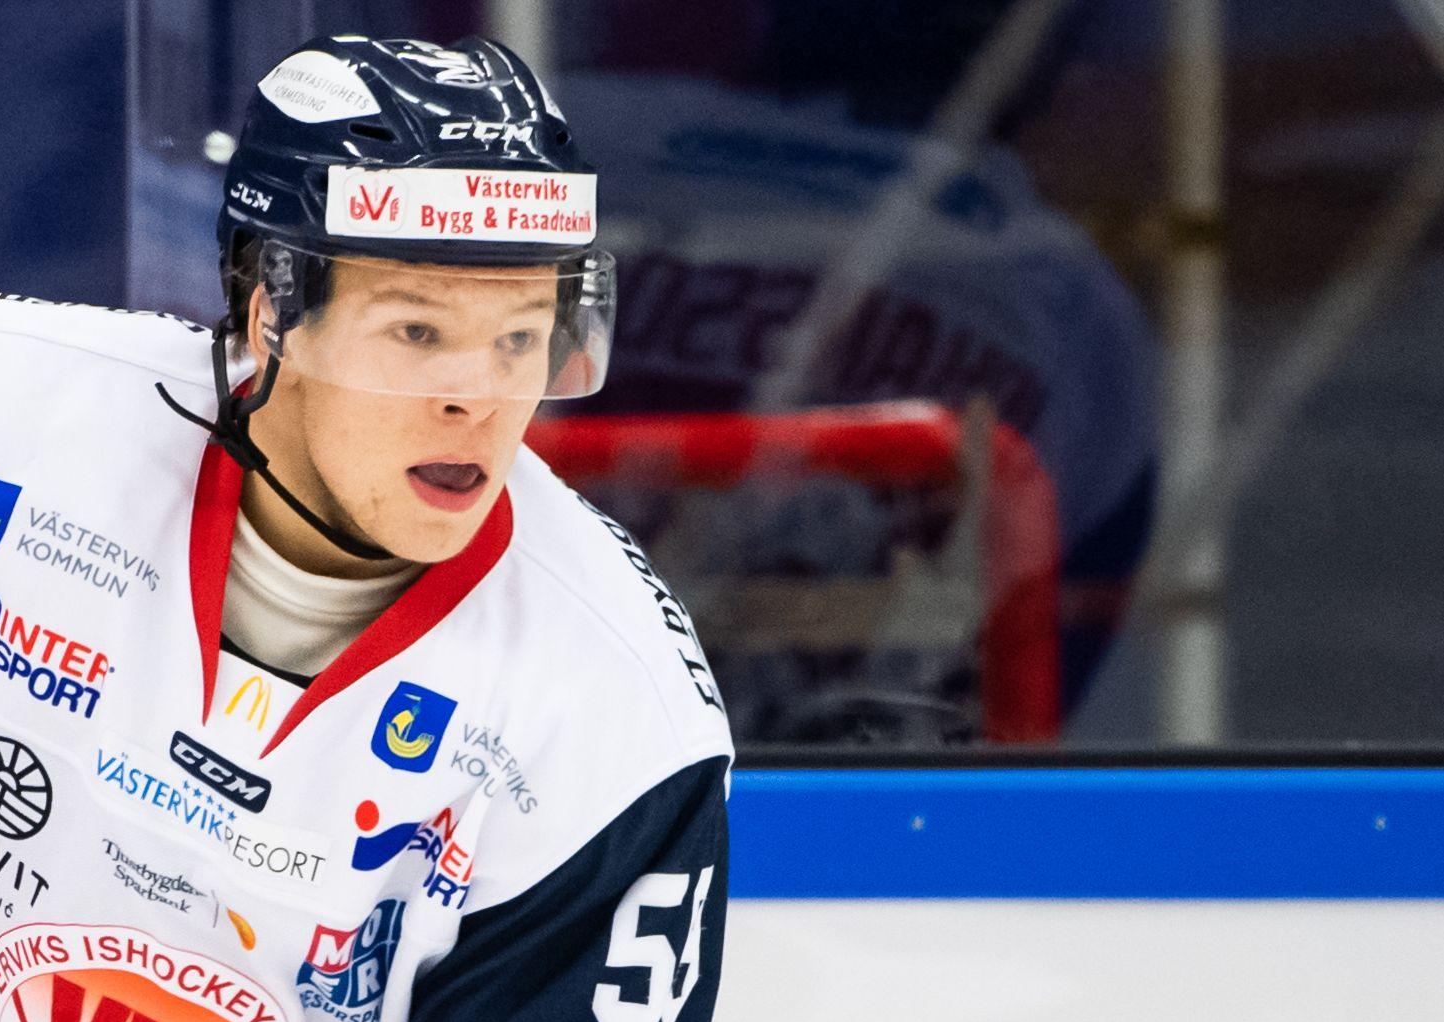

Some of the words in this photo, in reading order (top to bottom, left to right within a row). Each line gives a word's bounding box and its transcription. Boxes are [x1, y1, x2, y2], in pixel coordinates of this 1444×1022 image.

[439, 121, 534, 141] CCM
[466, 175, 569, 202] Västerviks
[421, 205, 474, 235] Bygg
[484, 207, 498, 229] &
[508, 208, 592, 234] Fasadteknik
[16, 534, 130, 599] KOMMUN
[28, 506, 162, 593] VÄSTERVIKS
[172, 739, 267, 802] CCM
